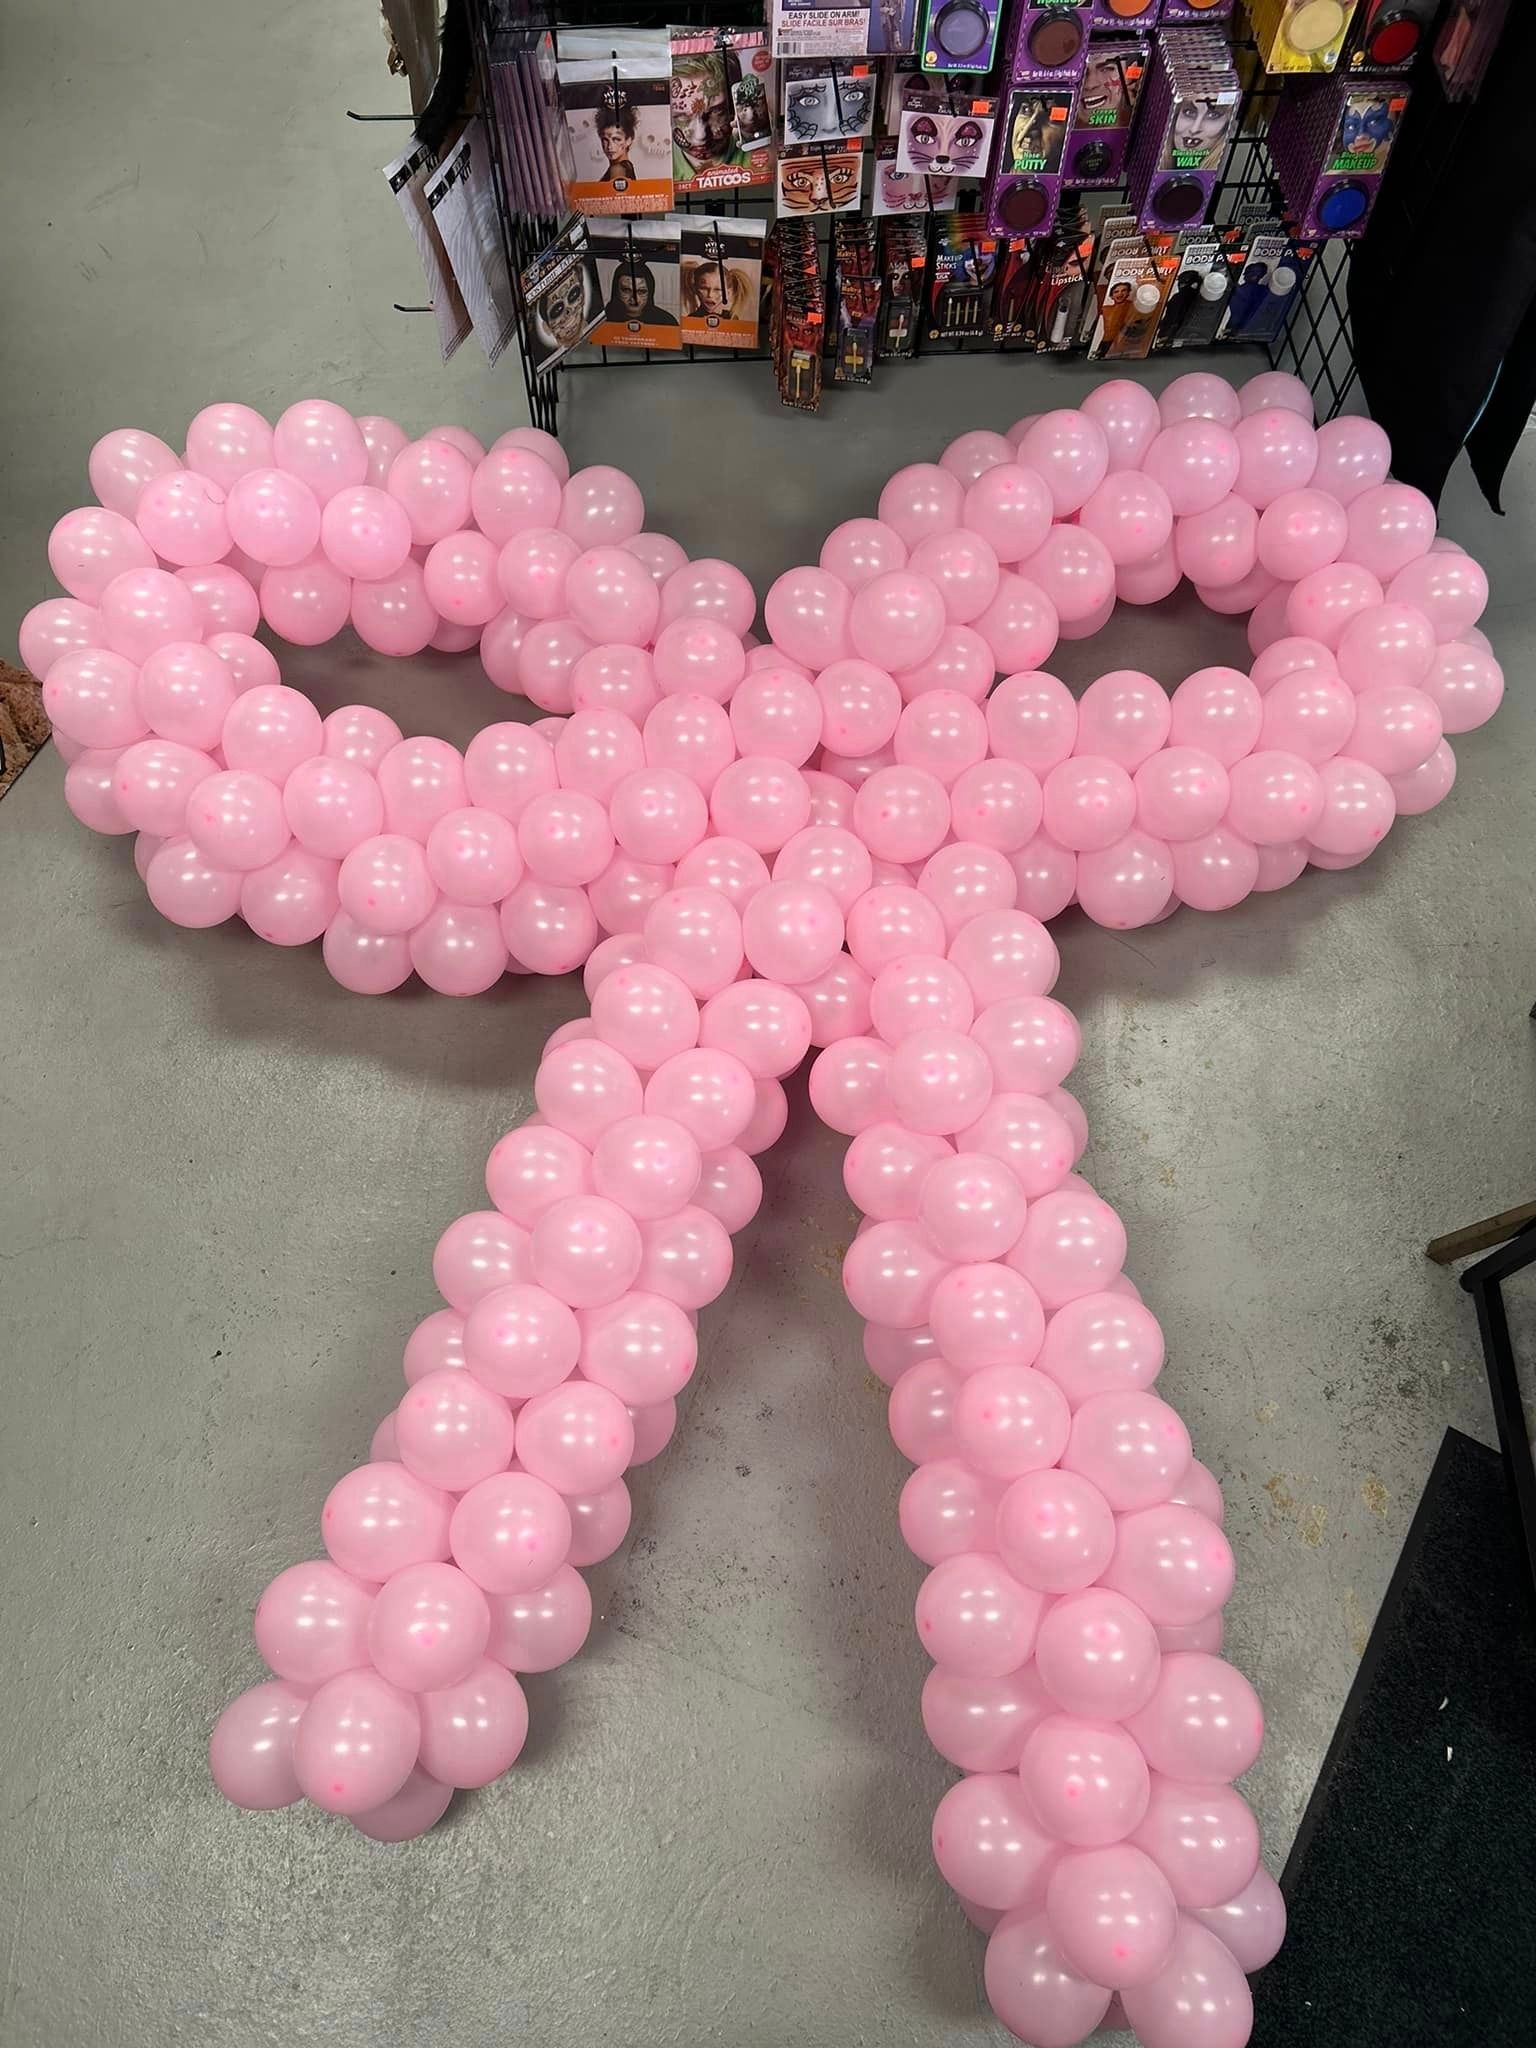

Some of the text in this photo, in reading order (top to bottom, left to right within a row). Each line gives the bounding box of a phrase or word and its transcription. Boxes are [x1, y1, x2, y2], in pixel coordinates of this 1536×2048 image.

[789, 11, 807, 20] EASY
[809, 11, 828, 19] SLIDE
[842, 10, 861, 18] ARM!
[782, 18, 866, 28] SLIDE FACILE SUR BRAS!
[1088, 114, 1117, 125] SKIN
[1014, 159, 1047, 170] PUTTY
[1176, 156, 1202, 167] WAX
[1332, 159, 1377, 169] MAKEUP
[460, 160, 472, 186] KIT
[707, 168, 739, 176] animated
[696, 172, 751, 189] TATTOOS
[1105, 228, 1133, 239] BODY
[1112, 247, 1139, 256] BODY
[1254, 247, 1281, 256] BODY
[936, 254, 963, 263] MAKEUP
[1185, 254, 1213, 264] BODY
[936, 262, 957, 270] STICKS
[1115, 267, 1144, 277] BODY
[1051, 273, 1083, 286] Lipstick
